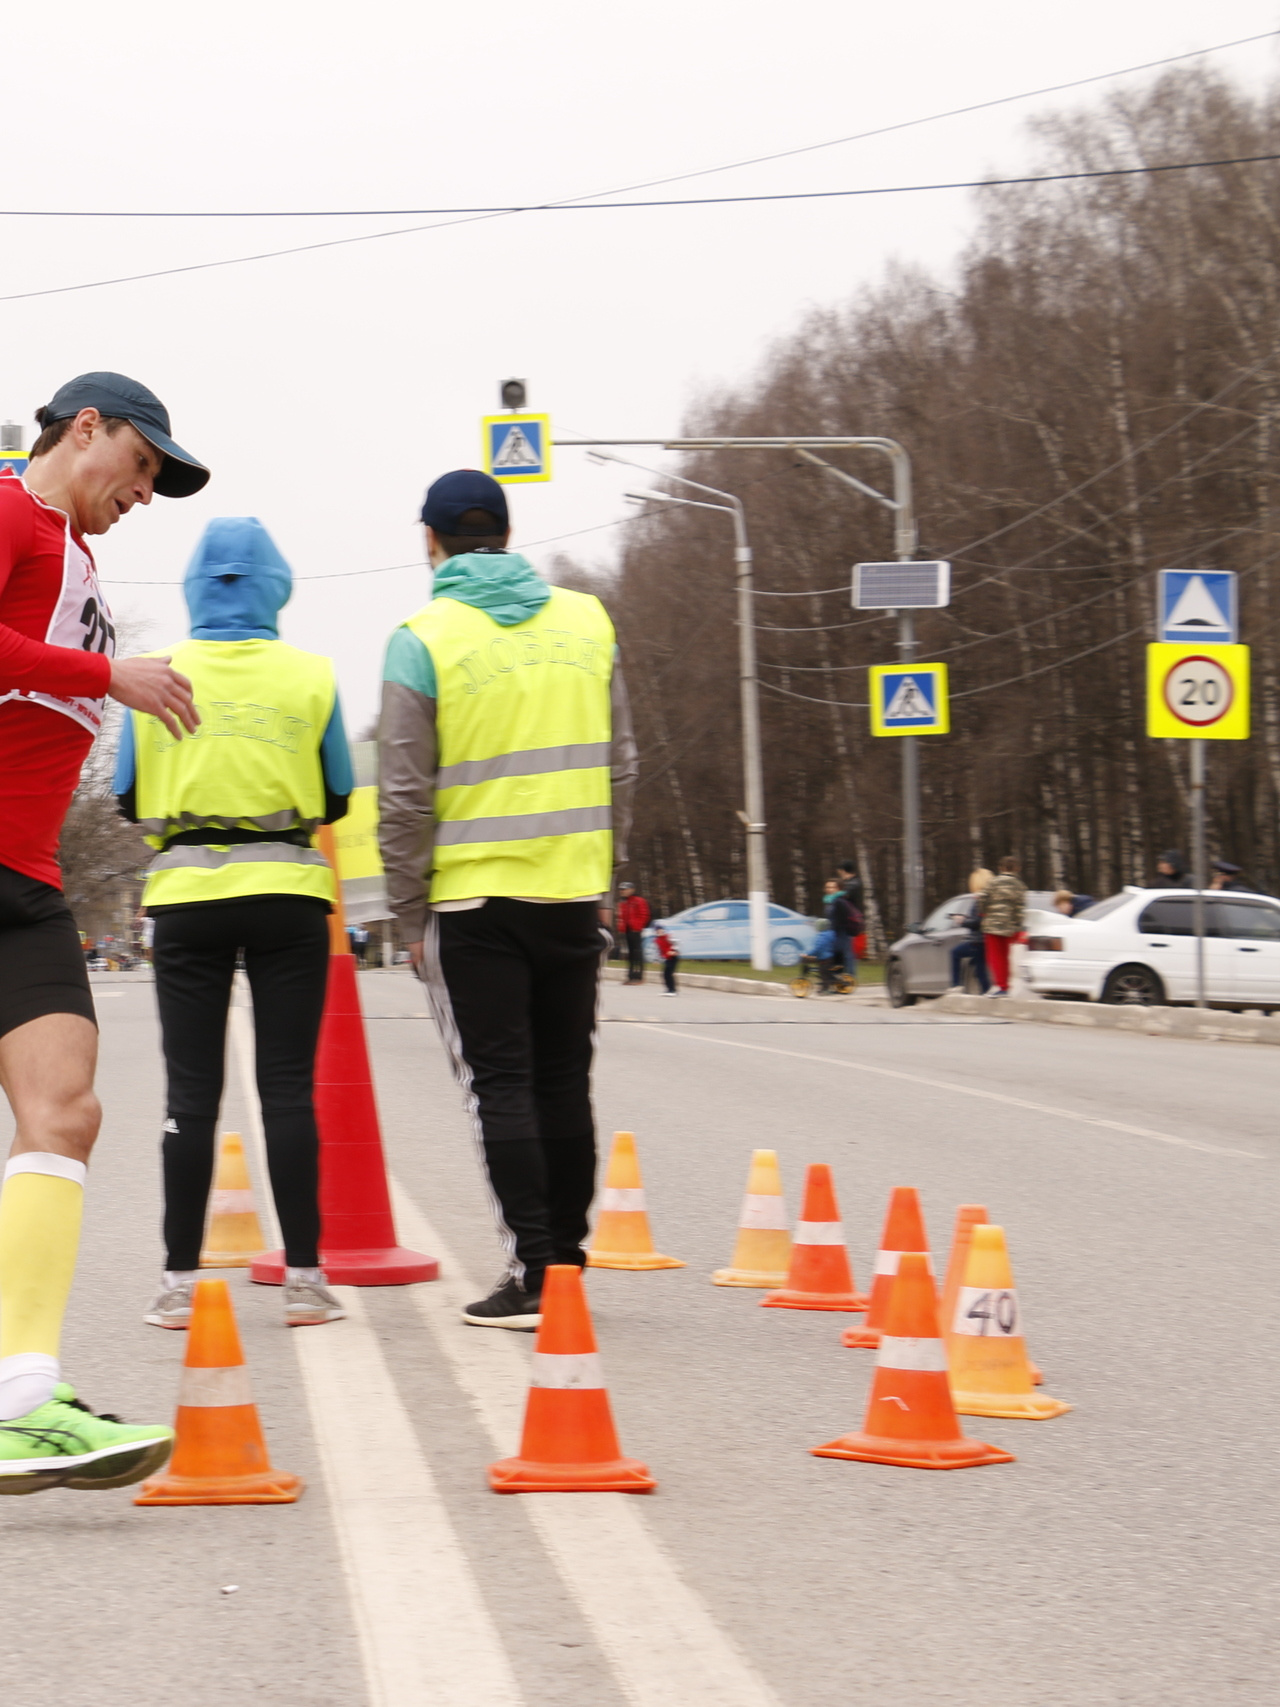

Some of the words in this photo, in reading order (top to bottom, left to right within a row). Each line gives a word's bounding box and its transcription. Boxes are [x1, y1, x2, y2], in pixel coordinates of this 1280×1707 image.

[455, 629, 602, 694] ЛОБНЯ
[1179, 678, 1221, 706] 20
[966, 1291, 1017, 1337] 40
